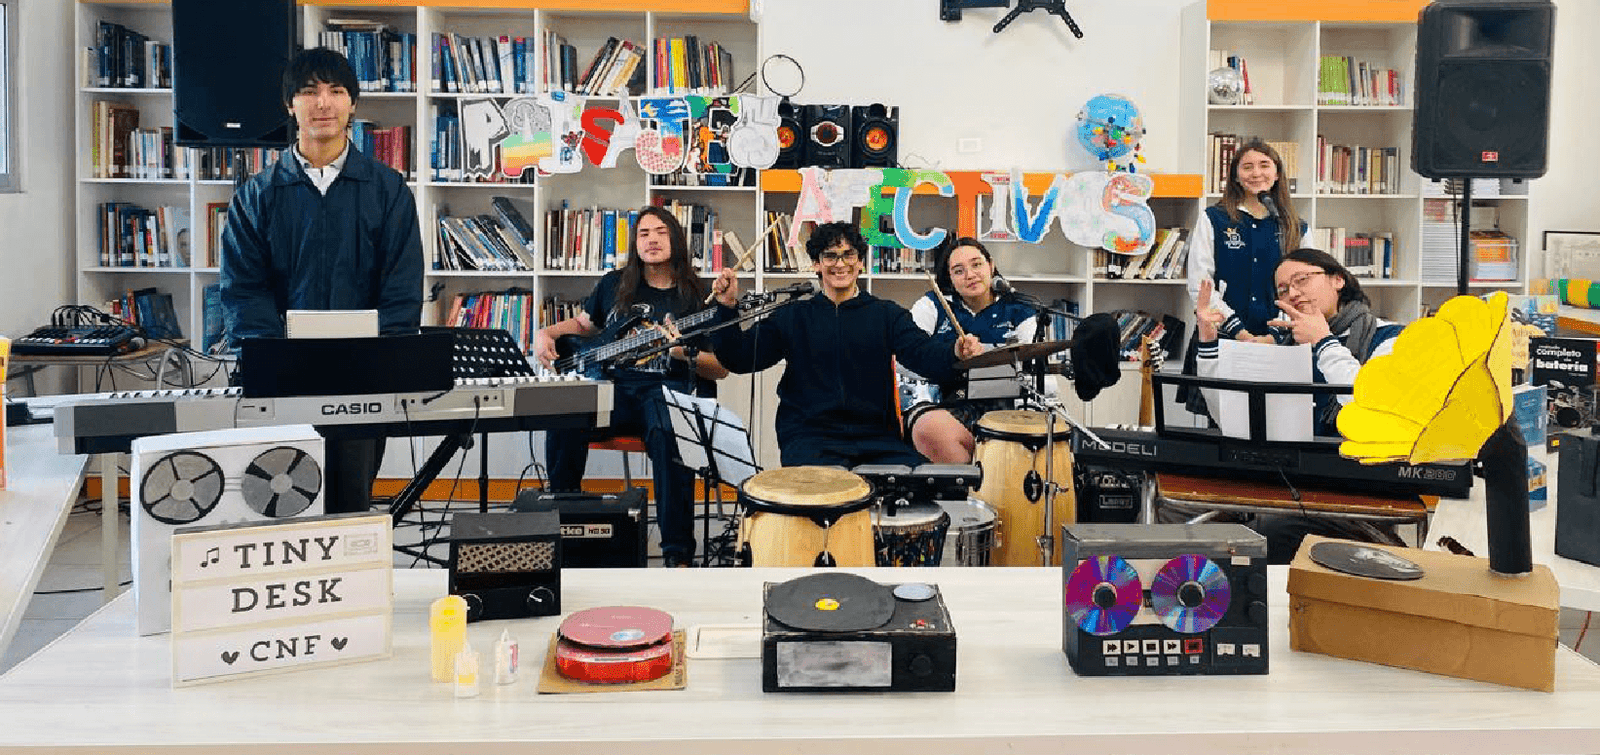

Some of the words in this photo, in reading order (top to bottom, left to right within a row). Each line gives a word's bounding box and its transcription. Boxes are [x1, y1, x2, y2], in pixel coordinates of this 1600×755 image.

[461, 90, 781, 178] PAISAJES
[787, 165, 1155, 255] AFECTIVOS
[1536, 347, 1582, 358] completo
[321, 402, 382, 415] CASIO
[233, 535, 340, 569] TINY
[231, 577, 343, 614] DESK
[249, 634, 321, 662] CNF
